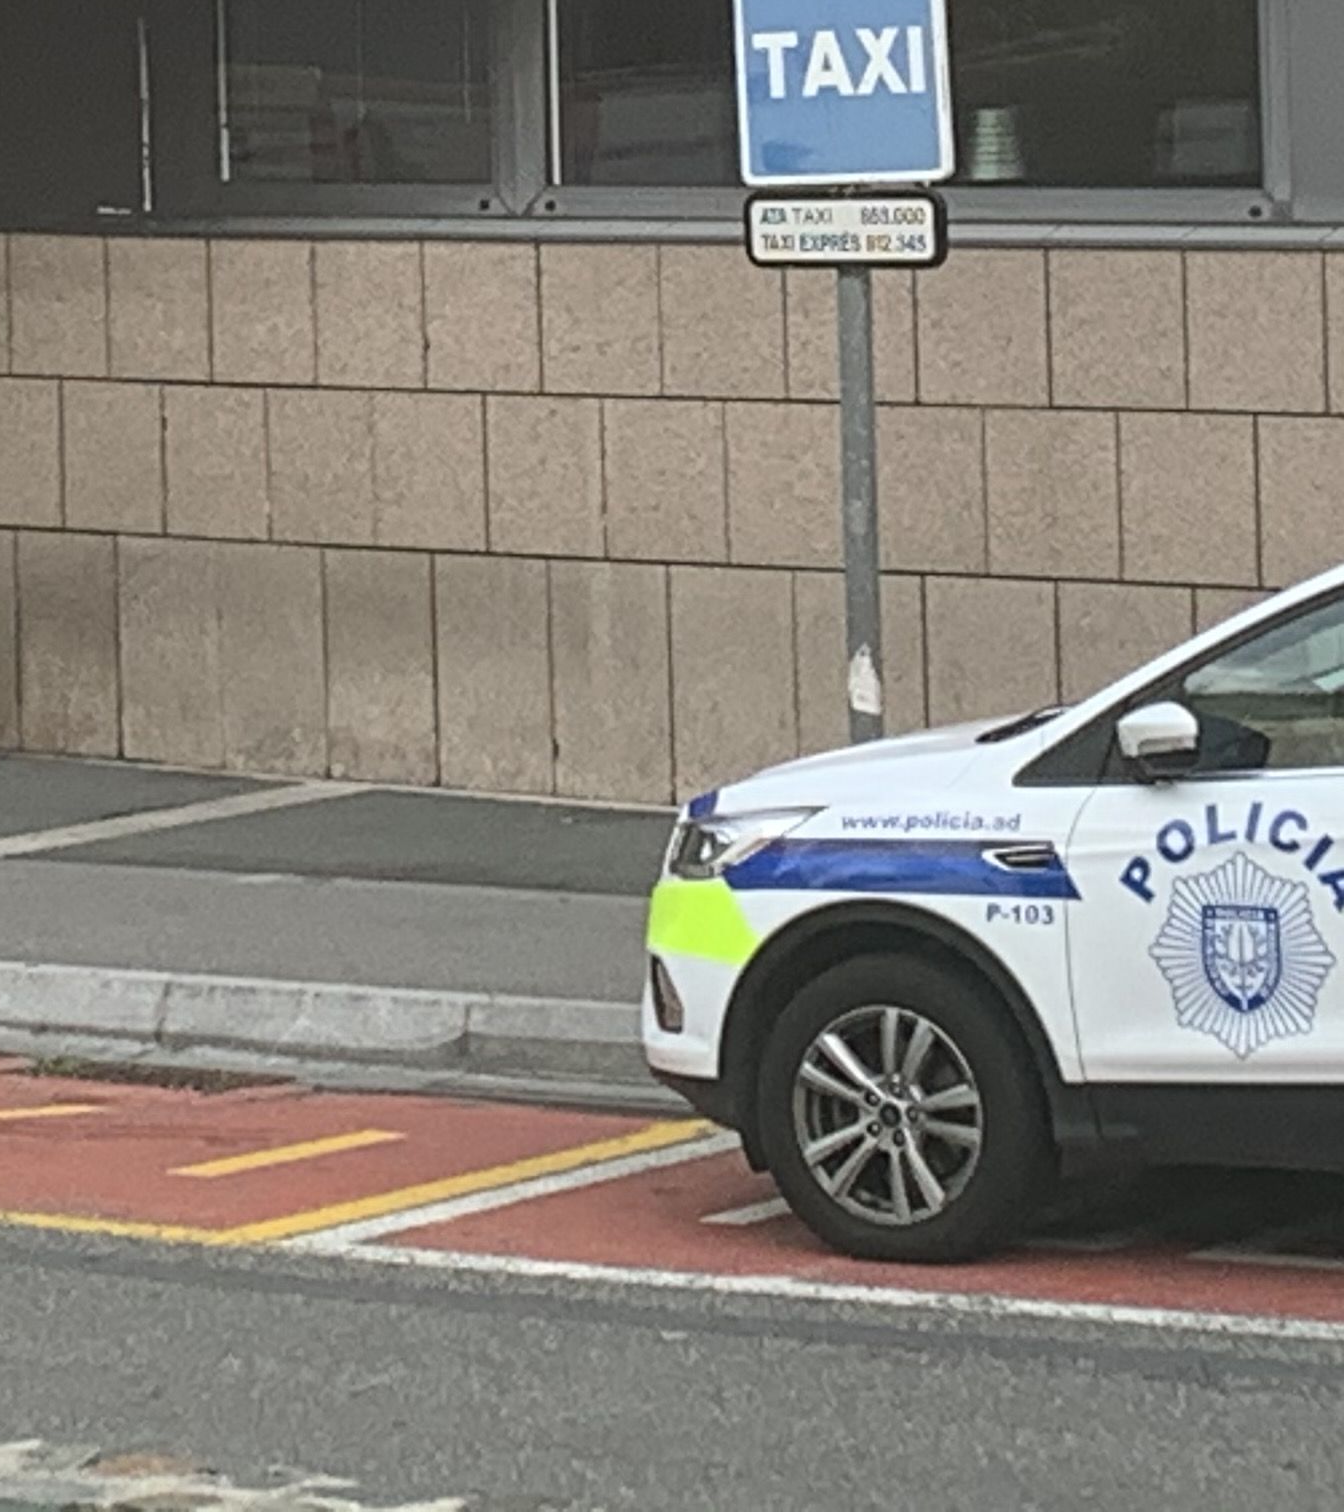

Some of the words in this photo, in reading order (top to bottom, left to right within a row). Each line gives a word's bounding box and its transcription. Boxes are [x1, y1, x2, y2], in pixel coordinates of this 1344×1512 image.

[751, 25, 928, 100] TAXI
[791, 206, 834, 226] TAXI
[761, 234, 796, 252] TAXI
[842, 811, 1022, 833] www.policia.ad
[986, 902, 1055, 925] P-103
